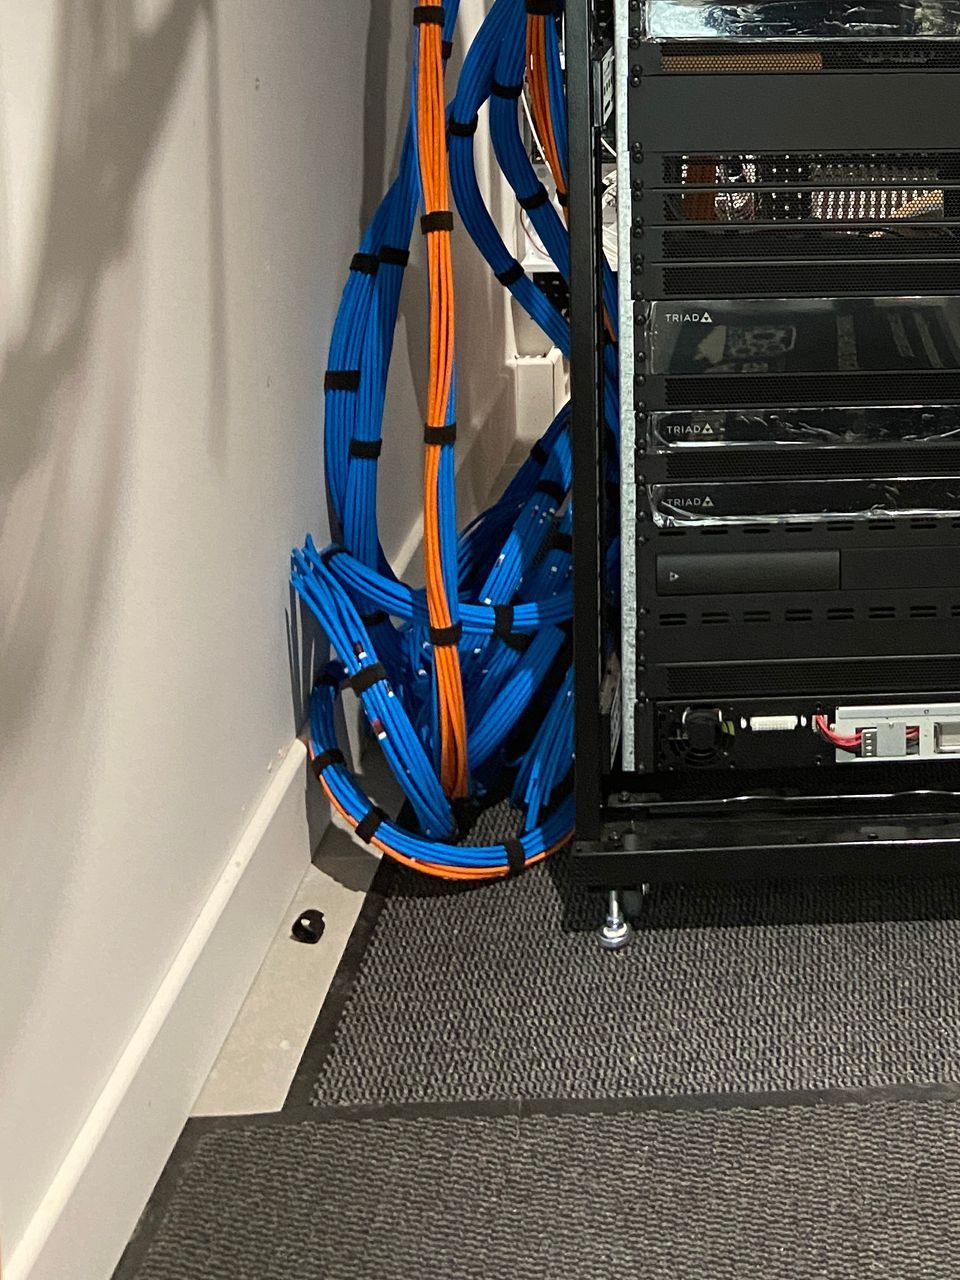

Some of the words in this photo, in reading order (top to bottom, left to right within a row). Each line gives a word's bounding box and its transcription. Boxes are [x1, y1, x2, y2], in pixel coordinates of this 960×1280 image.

[665, 313, 700, 322] TRIAD
[666, 425, 701, 434] TRIAD
[666, 497, 701, 507] TRIAD
